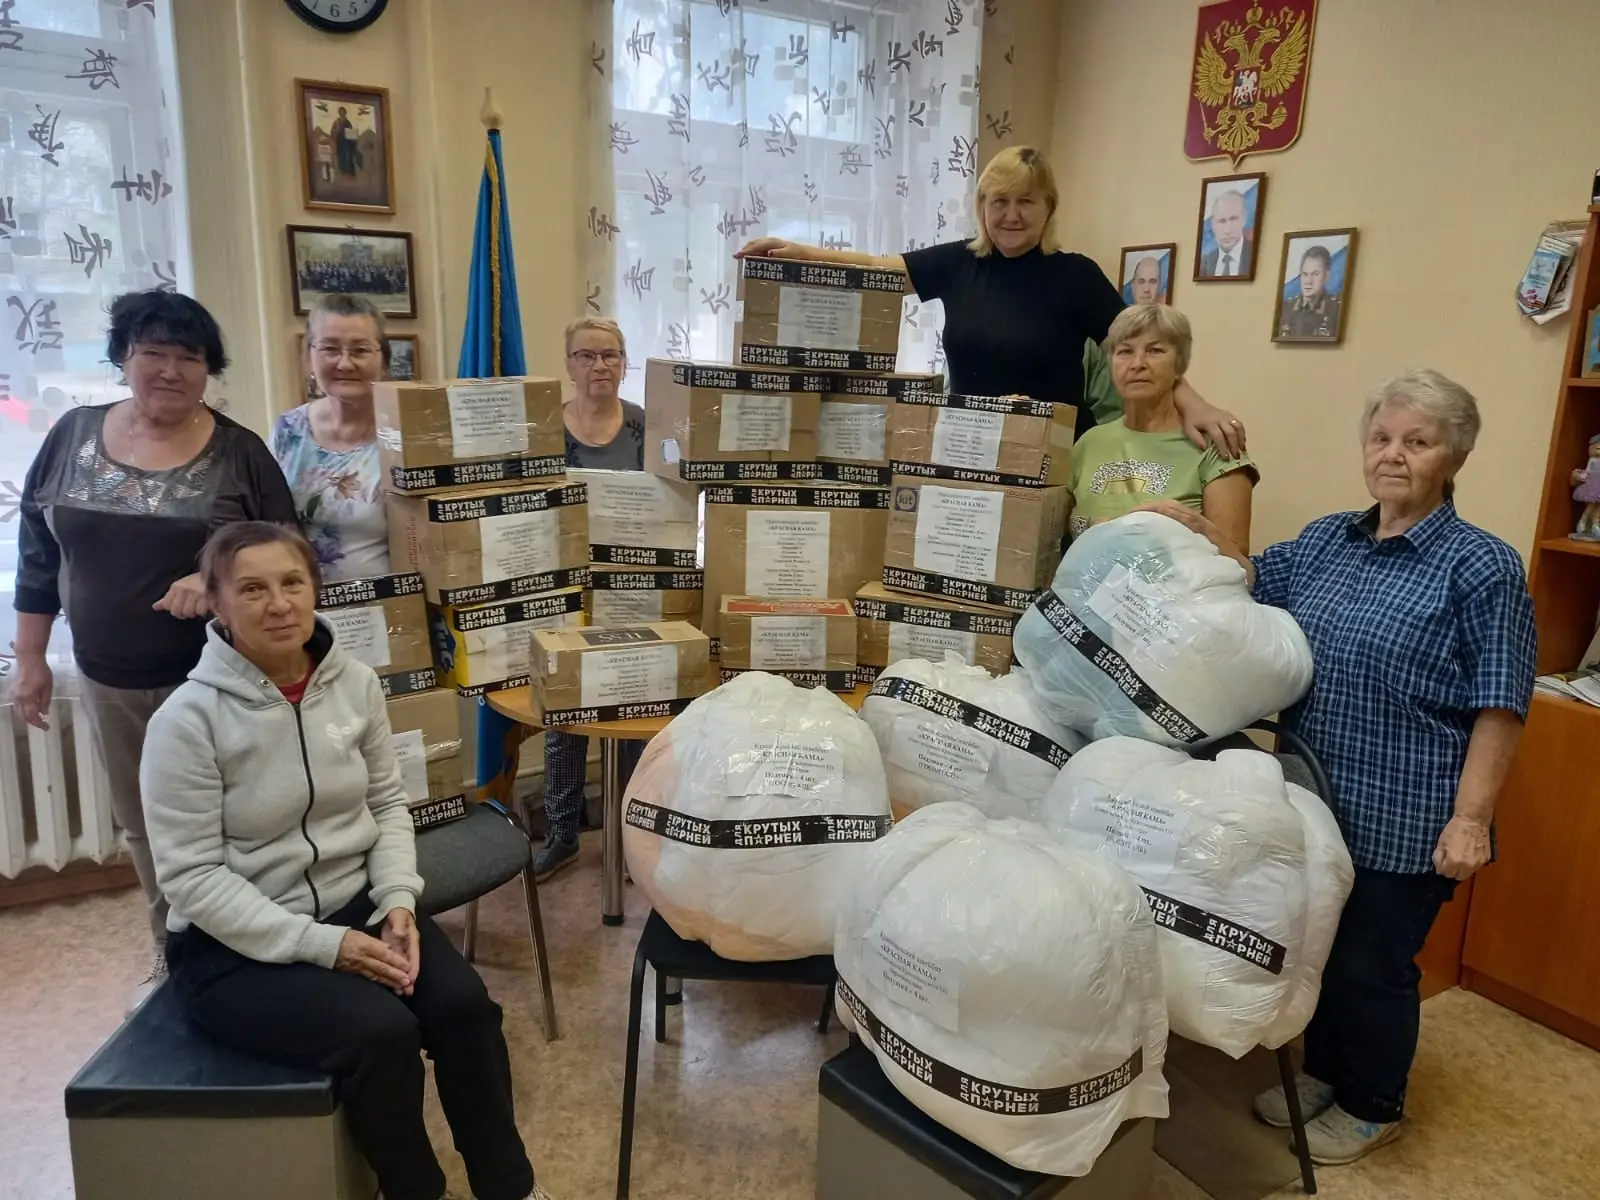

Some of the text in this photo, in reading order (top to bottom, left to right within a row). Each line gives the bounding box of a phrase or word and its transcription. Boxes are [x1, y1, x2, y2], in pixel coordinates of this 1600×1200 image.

[330, 4, 340, 18] 6
[348, 2, 358, 16] 5
[745, 261, 783, 272] КРУТЫХ
[808, 267, 846, 278] КРУТЫХ
[750, 347, 788, 357] КРУТЫХ
[811, 352, 849, 361] КРУТЫХ
[873, 355, 896, 363] КРУТ
[701, 369, 737, 379] КРУТЫХ
[757, 374, 791, 383] КРУТЫХ
[462, 463, 503, 474] КРУТЫХ
[528, 458, 566, 468] КРУТЫХ
[690, 463, 725, 472] КРУТЫХ
[745, 464, 778, 472] КРУТЫХ
[844, 466, 879, 476] КРУТЫХ
[898, 463, 937, 476] КРУТЫХ
[960, 472, 1001, 483] КРУТЫХ
[508, 492, 547, 504] КРУТЫХ
[758, 489, 798, 497] КРУТЫХ
[821, 491, 860, 499] КРУТЫХ
[445, 500, 485, 512] КРУТЫХ
[618, 548, 656, 557] КРУТЫХ
[517, 574, 554, 587] КРУТЫХ
[616, 574, 655, 582] КРУТЫХ
[679, 574, 702, 582] КРУТ
[889, 569, 926, 582] КРУТЫХ
[950, 580, 988, 592] КРУТЫХ
[455, 586, 495, 599] КРУТЫХ
[529, 597, 566, 610] КРУТЫХ
[855, 600, 886, 611] РУТЫХ
[466, 607, 505, 620] КРУТЫХ
[910, 608, 951, 620] КРУТЫХ
[977, 616, 1012, 626] КРУТЫ
[1054, 603, 1087, 637] КРУТЫХ
[1106, 652, 1143, 690] КРУТЫХ
[914, 686, 961, 710] КРУТЫХ
[626, 703, 671, 714] КРУТЫХ
[552, 710, 599, 721] КРУТЫХ
[985, 716, 1032, 740] КРУТЫХ
[421, 798, 463, 816] КРУТЫХ
[632, 804, 659, 820] КРУТЫХ
[672, 816, 711, 834] КРУТЫХ
[744, 821, 801, 834] КРУТЫХ
[837, 819, 876, 830] КРУТЫХ
[1148, 894, 1180, 916] ТЫХ
[1218, 923, 1274, 956] КРУТЫХ
[887, 1033, 934, 1072] КРУТЫХ
[1080, 1062, 1131, 1094] КРУТЫХ
[971, 1081, 1040, 1102] КРУТЫХ
